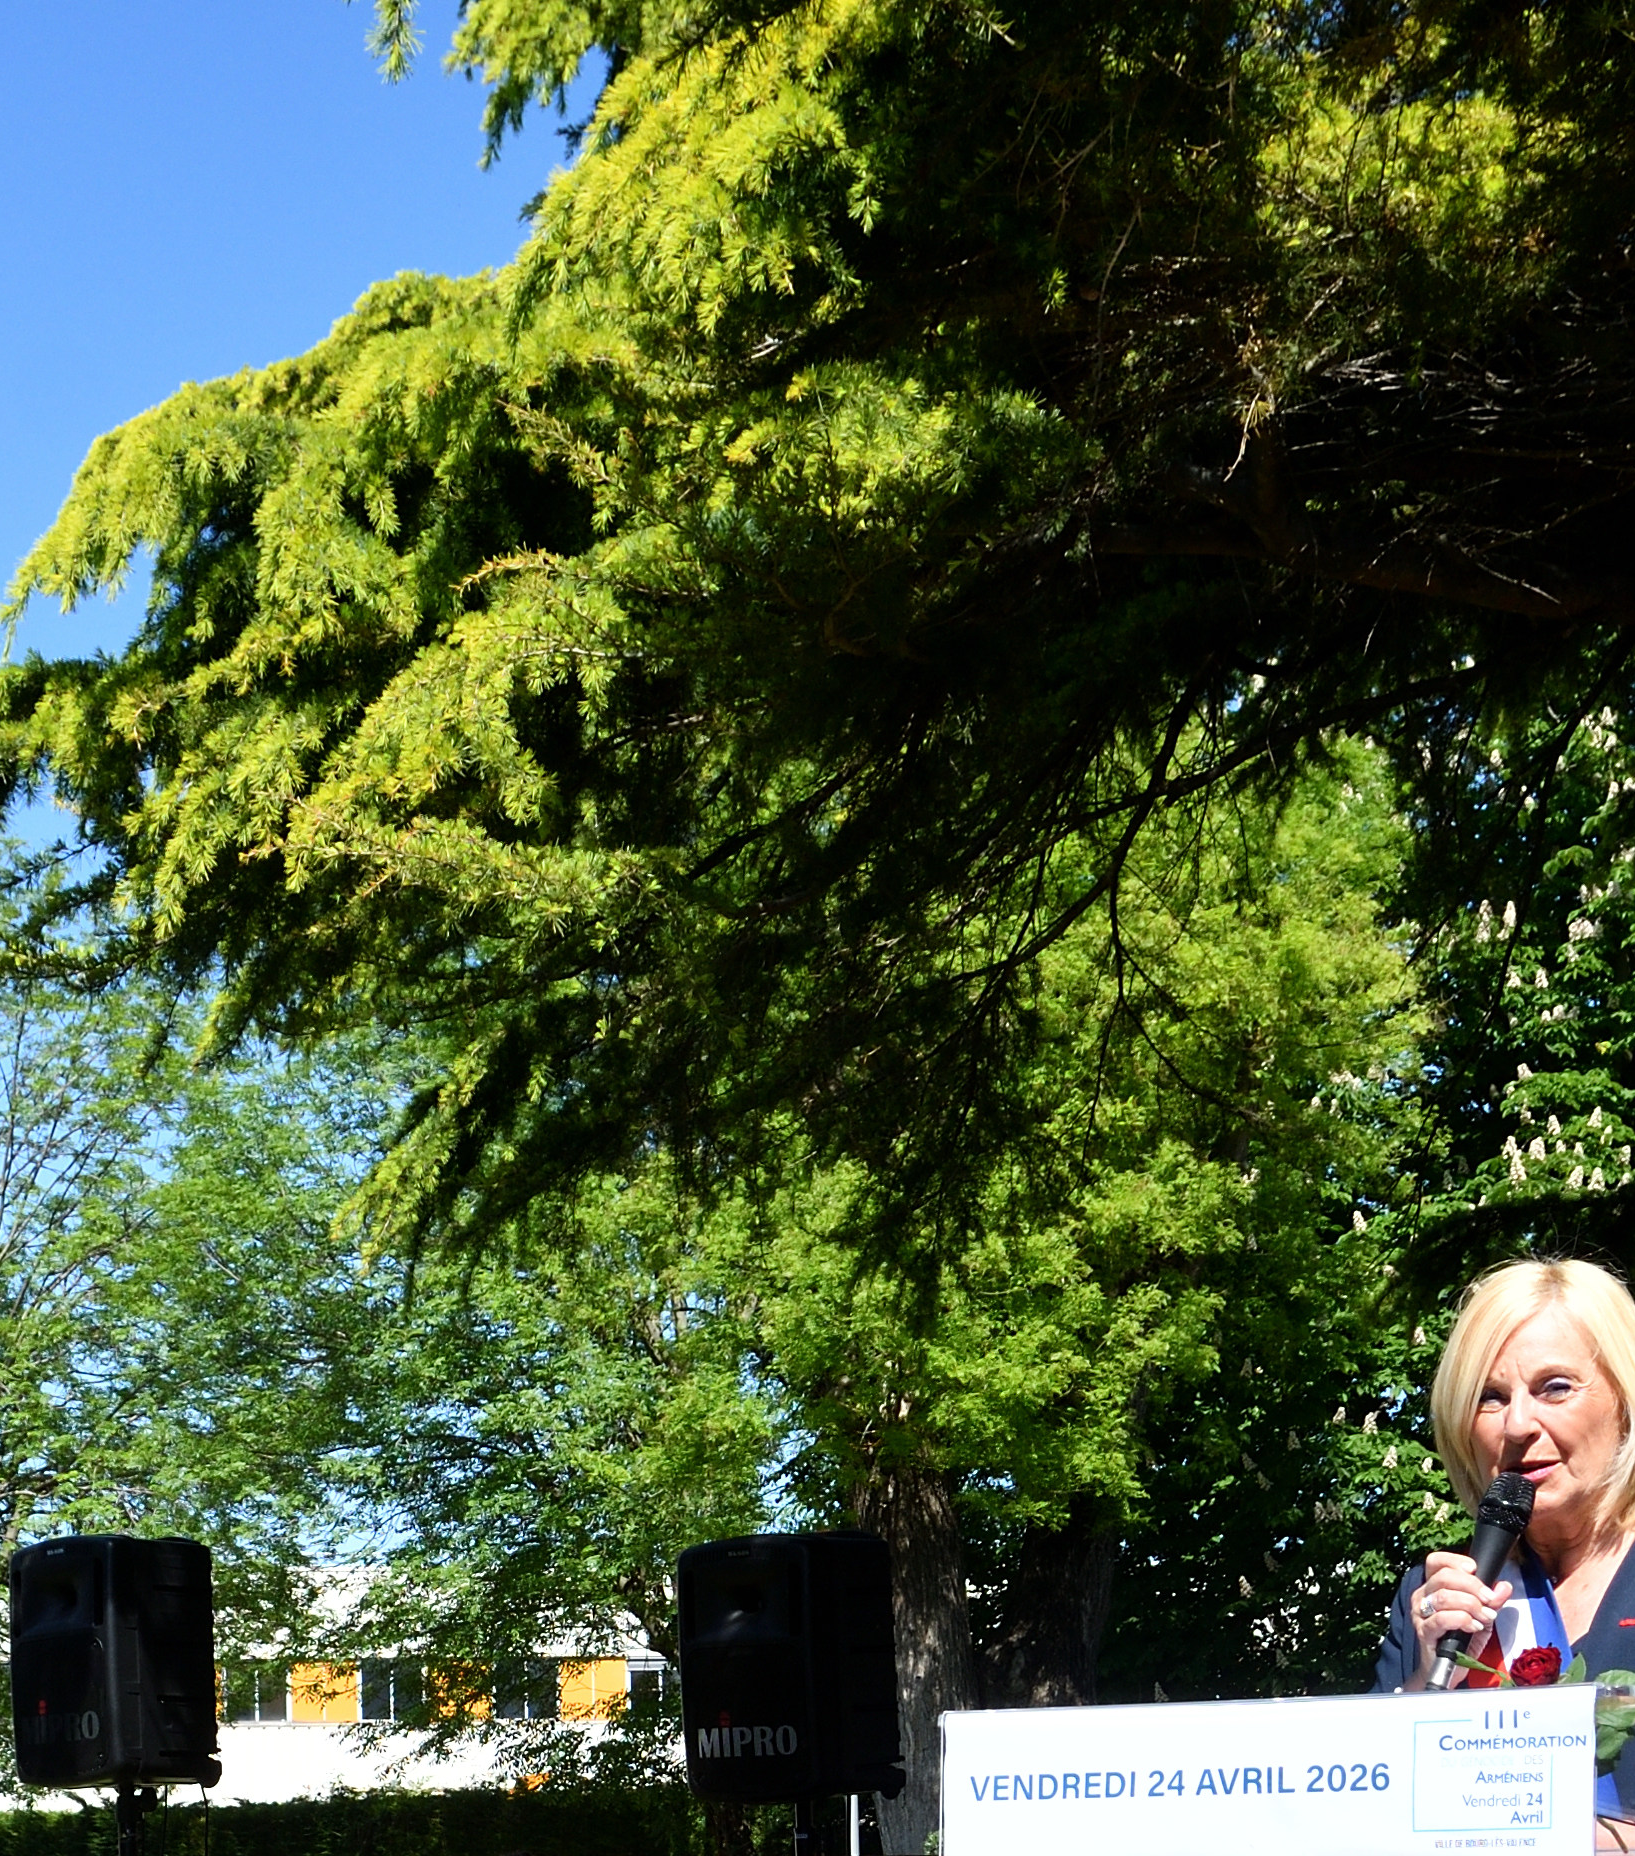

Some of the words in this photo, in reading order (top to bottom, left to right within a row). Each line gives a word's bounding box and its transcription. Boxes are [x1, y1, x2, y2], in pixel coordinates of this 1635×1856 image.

[697, 1725, 798, 1758] MIPRO
[1439, 1734, 1587, 1751] COMMÉMORATION
[1524, 1754, 1544, 1765] DES
[969, 1771, 1136, 1801] VENDREDI
[1147, 1769, 1186, 1797] 24
[1195, 1766, 1295, 1796] AVRIL
[1306, 1763, 1390, 1793] 2026
[1475, 1770, 1544, 1784] ARMÉNIENS
[1462, 1793, 1521, 1807] Vendredi
[1526, 1792, 1544, 1806] 24
[1510, 1810, 1543, 1824] Avril
